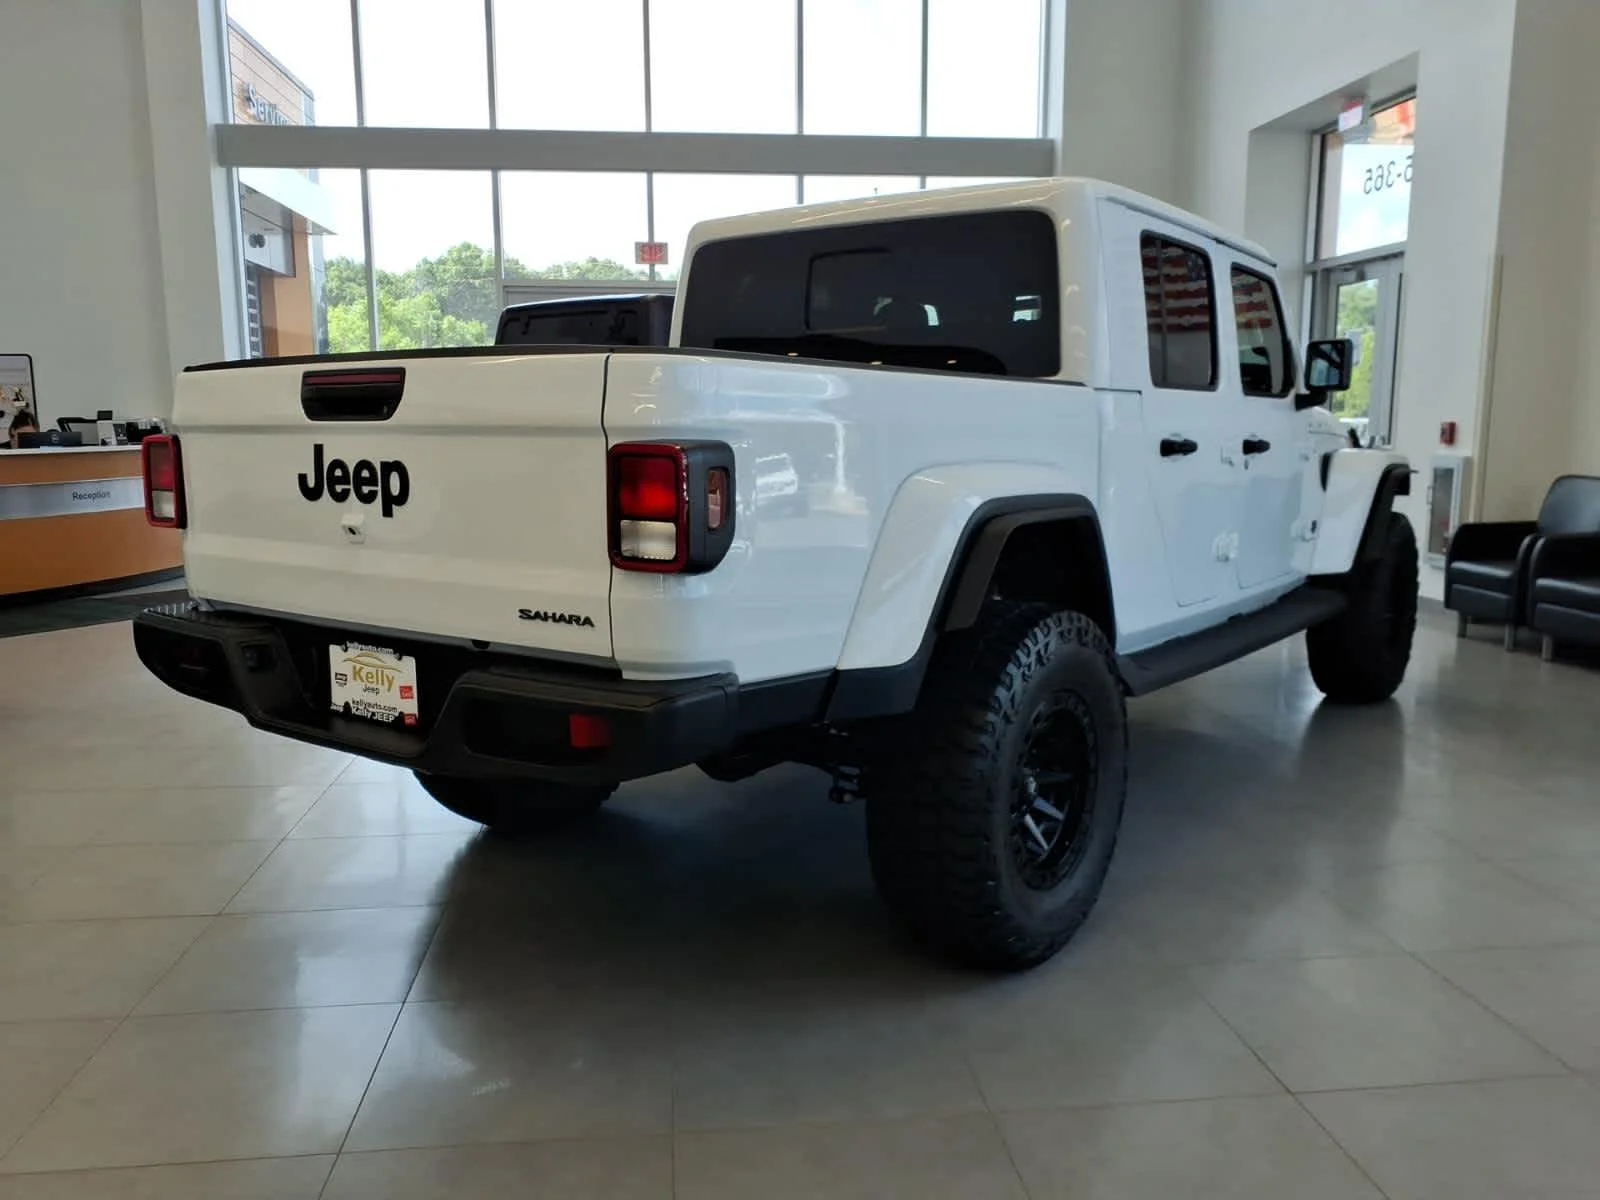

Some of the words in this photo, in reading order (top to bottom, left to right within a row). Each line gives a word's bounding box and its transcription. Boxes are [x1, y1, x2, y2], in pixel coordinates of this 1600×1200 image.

[298, 443, 410, 518] Jeep
[72, 490, 111, 502] Reception
[518, 608, 595, 628] SAHARA
[352, 665, 395, 693] Kelly
[362, 684, 380, 695] Jeep
[351, 706, 372, 719] Kelly
[372, 711, 395, 723] JEEP
